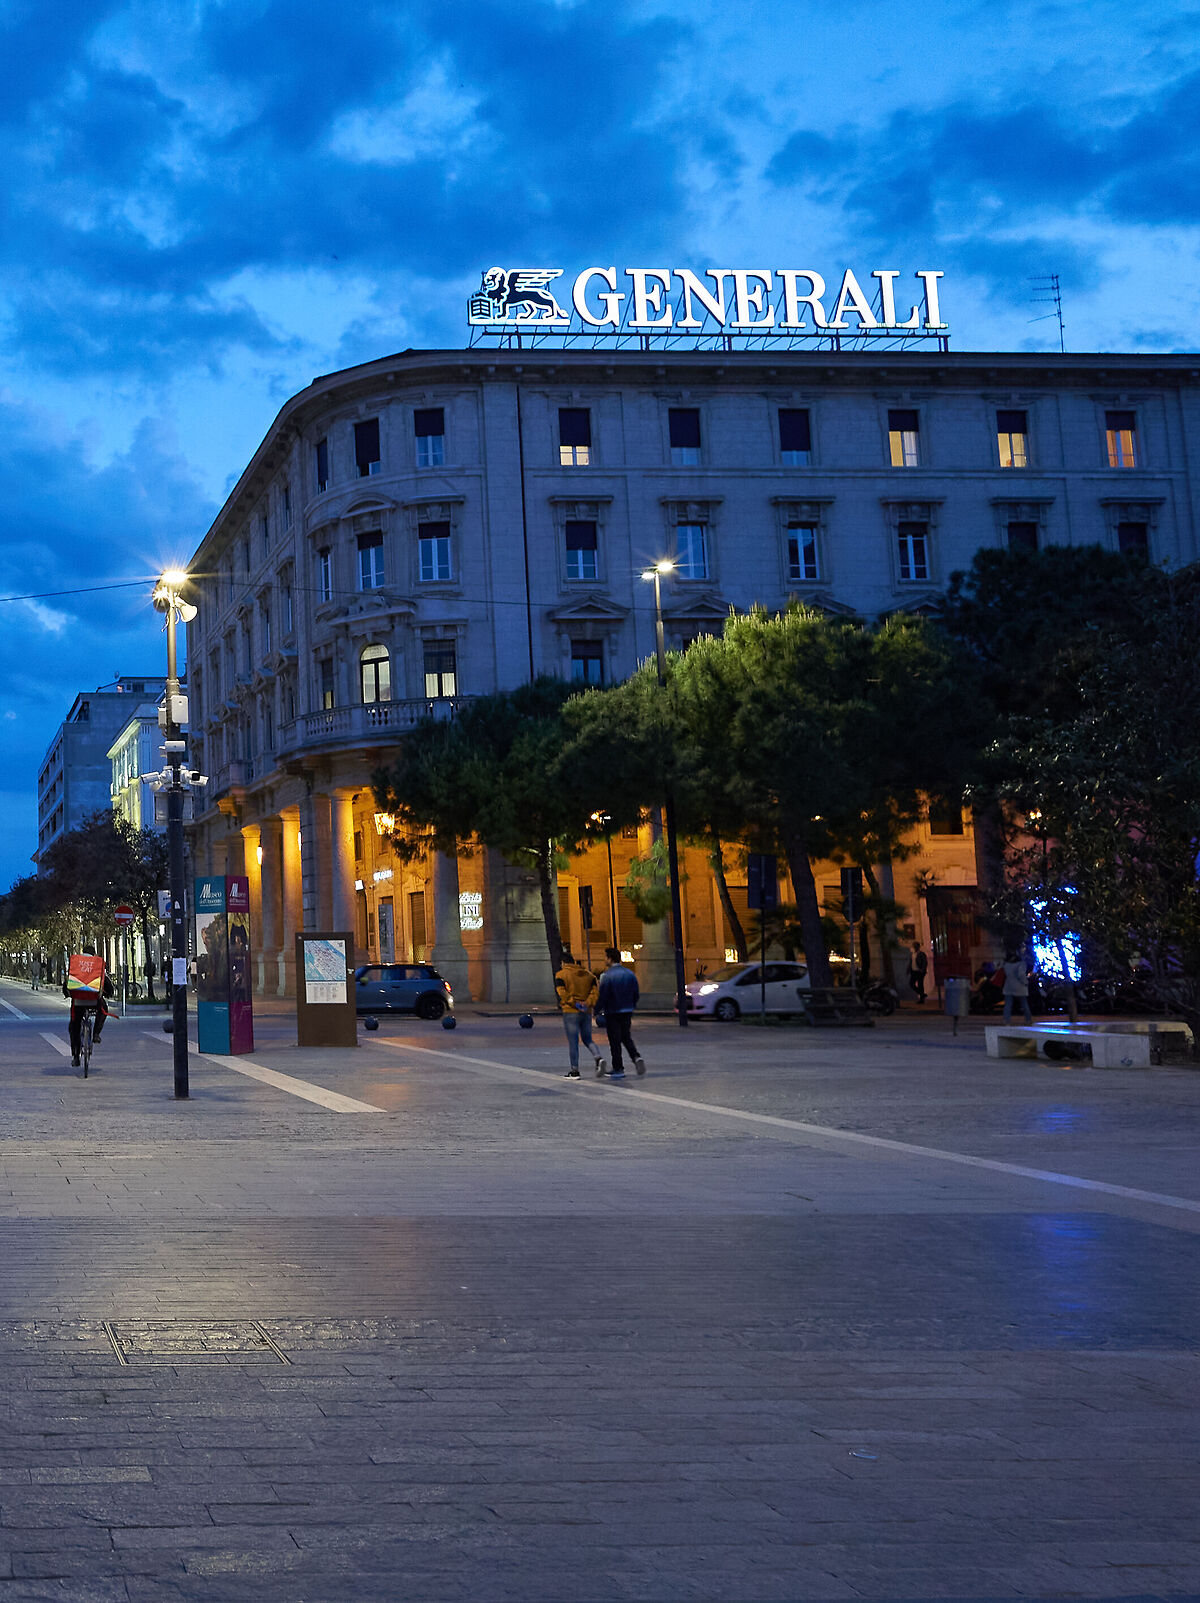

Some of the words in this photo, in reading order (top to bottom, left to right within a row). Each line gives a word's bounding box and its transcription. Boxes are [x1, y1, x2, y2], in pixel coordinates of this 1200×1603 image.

[571, 266, 949, 330] GENERALI
[79, 960, 95, 968] JUST
[80, 966, 94, 974] EAT
